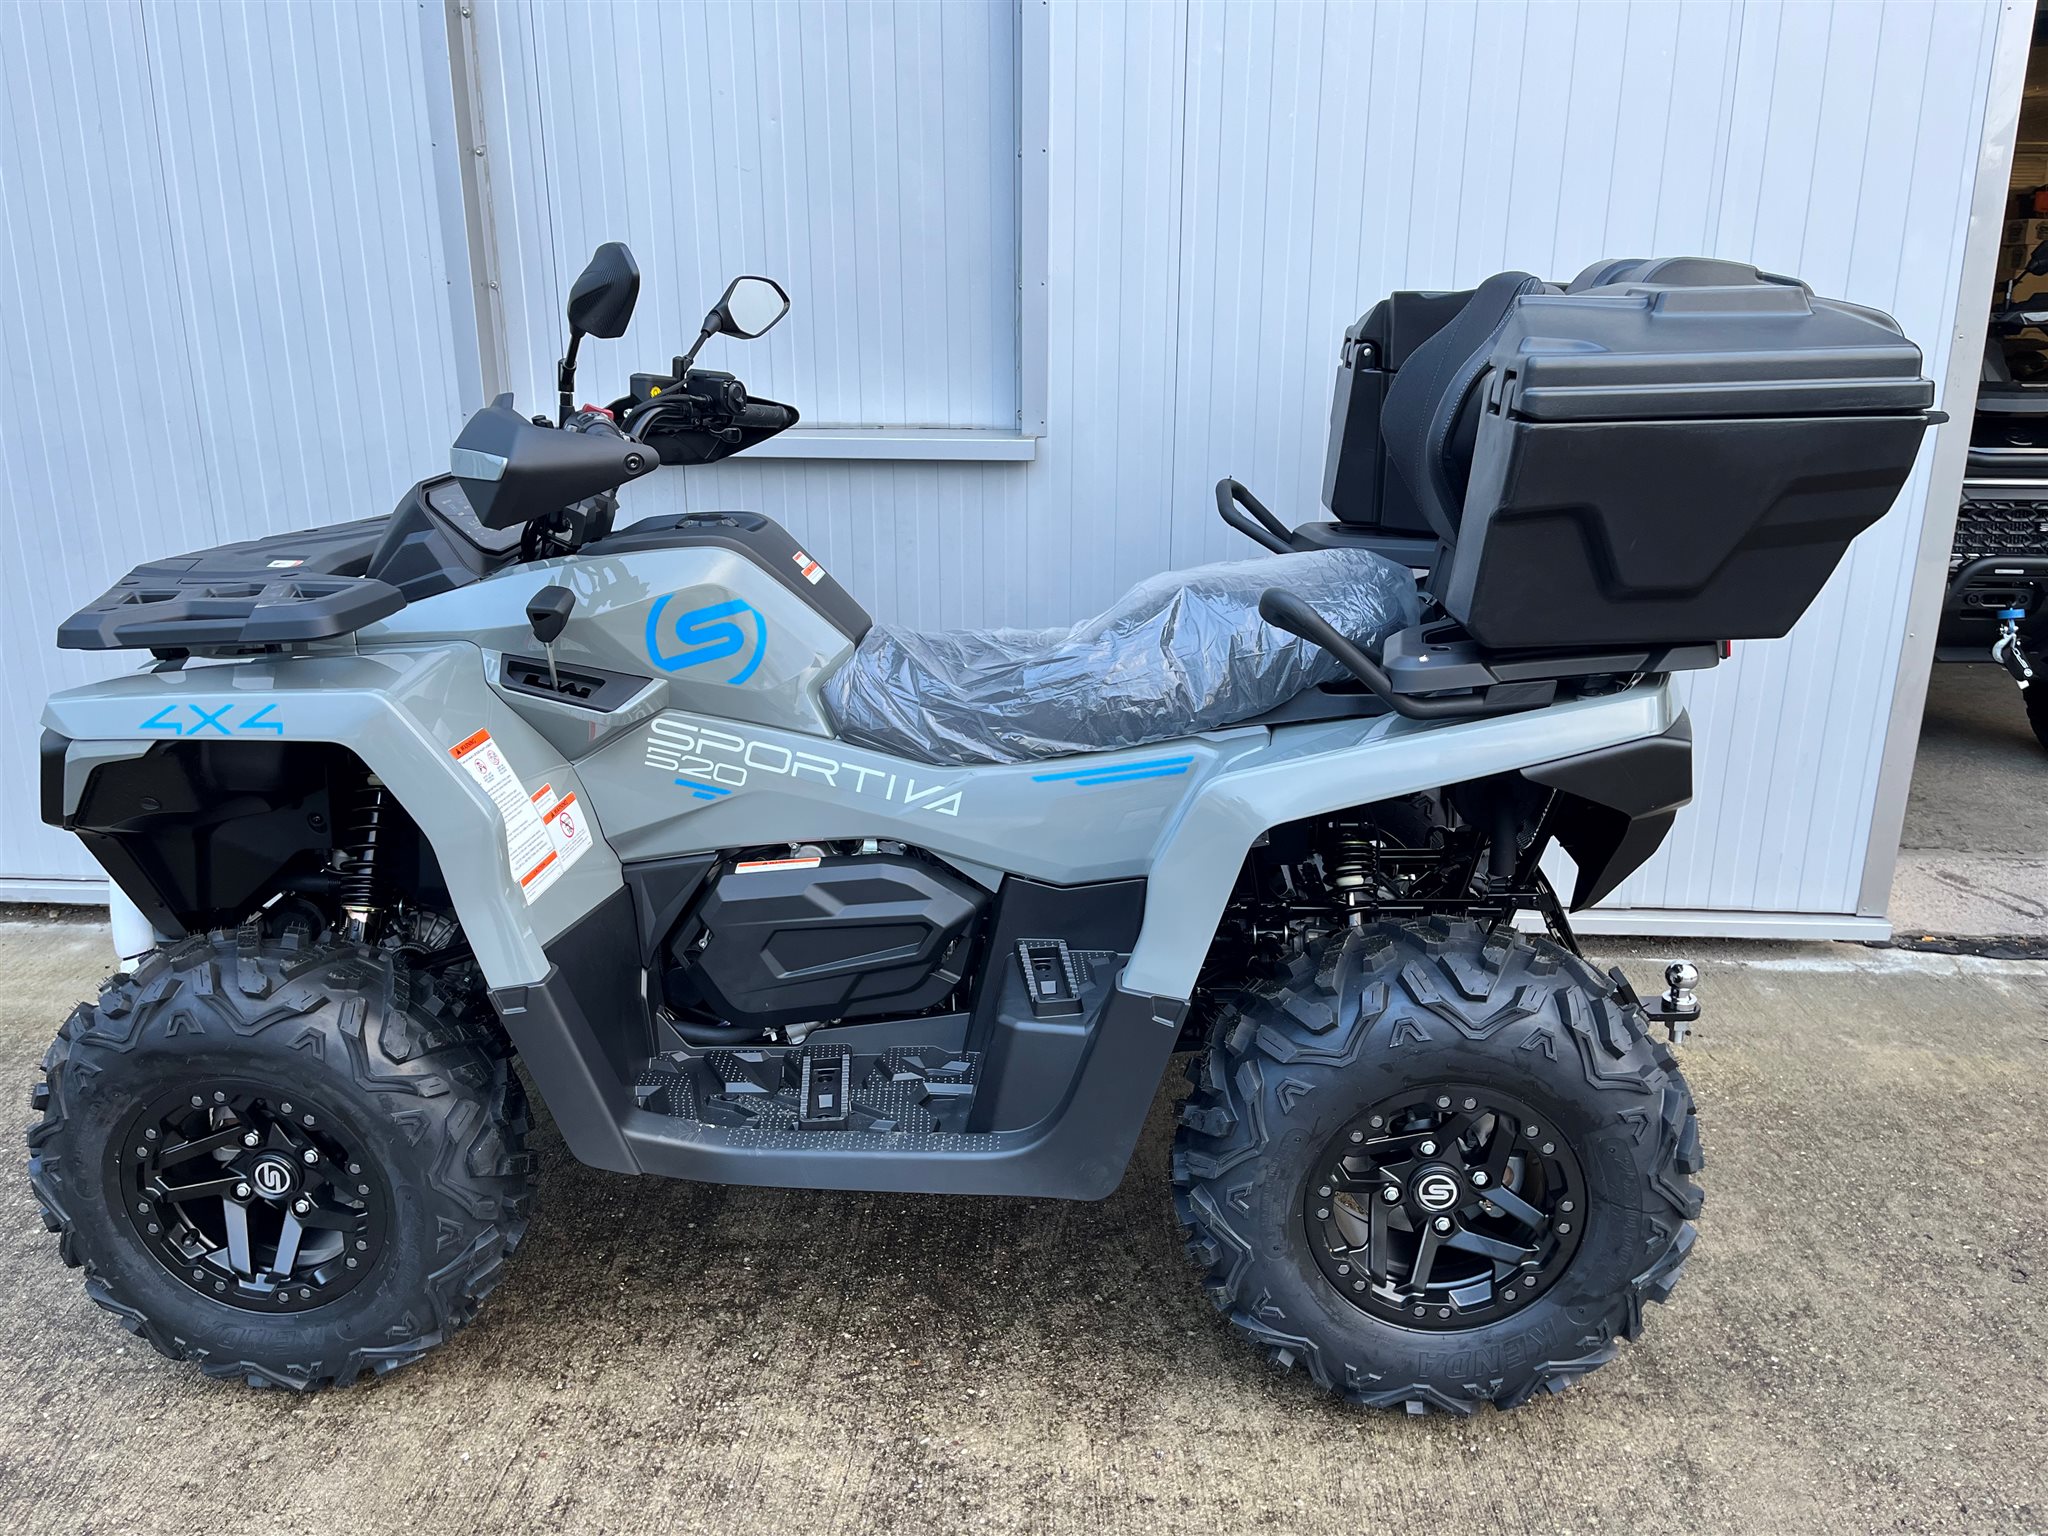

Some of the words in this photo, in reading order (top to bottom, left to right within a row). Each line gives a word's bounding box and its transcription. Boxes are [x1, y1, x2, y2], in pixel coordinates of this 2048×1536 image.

[138, 703, 284, 736] 4X4
[644, 746, 748, 787] 520
[647, 718, 963, 817] SPORTIVA
